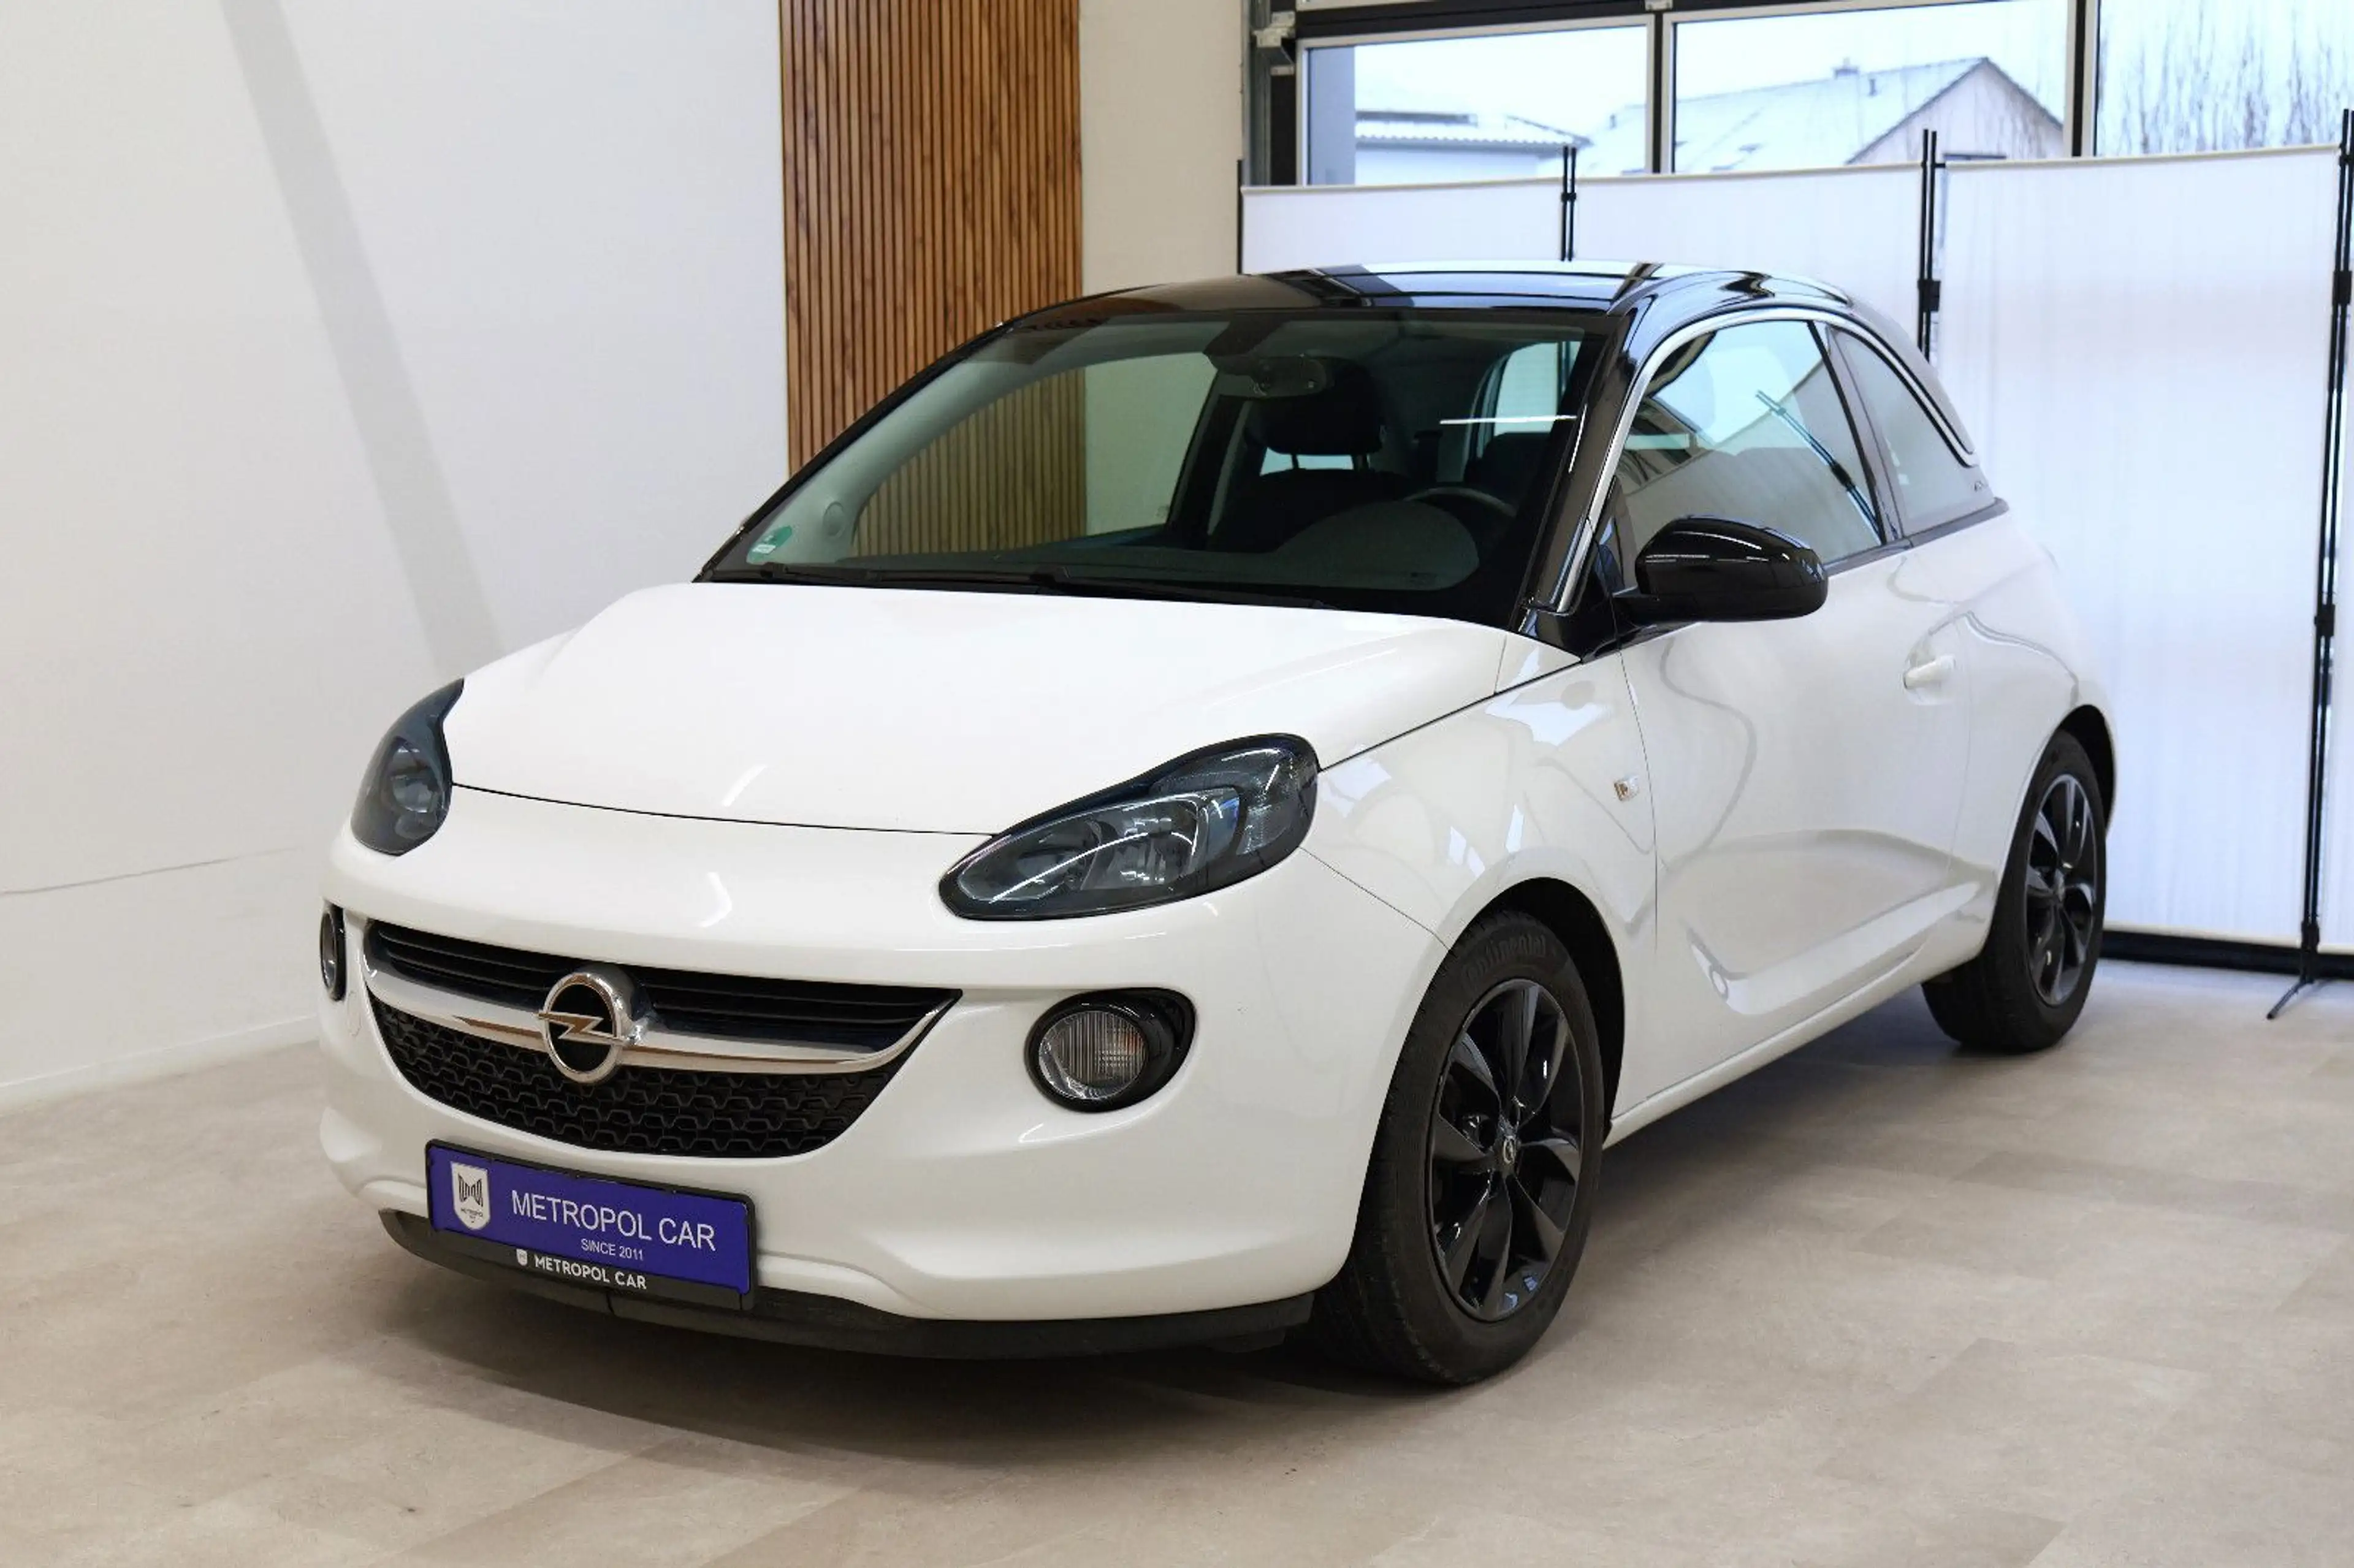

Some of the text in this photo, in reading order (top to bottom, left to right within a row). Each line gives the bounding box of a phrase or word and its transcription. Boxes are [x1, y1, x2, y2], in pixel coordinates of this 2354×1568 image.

[512, 1190, 715, 1251] METROPOL CAR
[581, 1238, 644, 1260] SINCE 2011
[534, 1254, 647, 1289] METROPOL CAR
